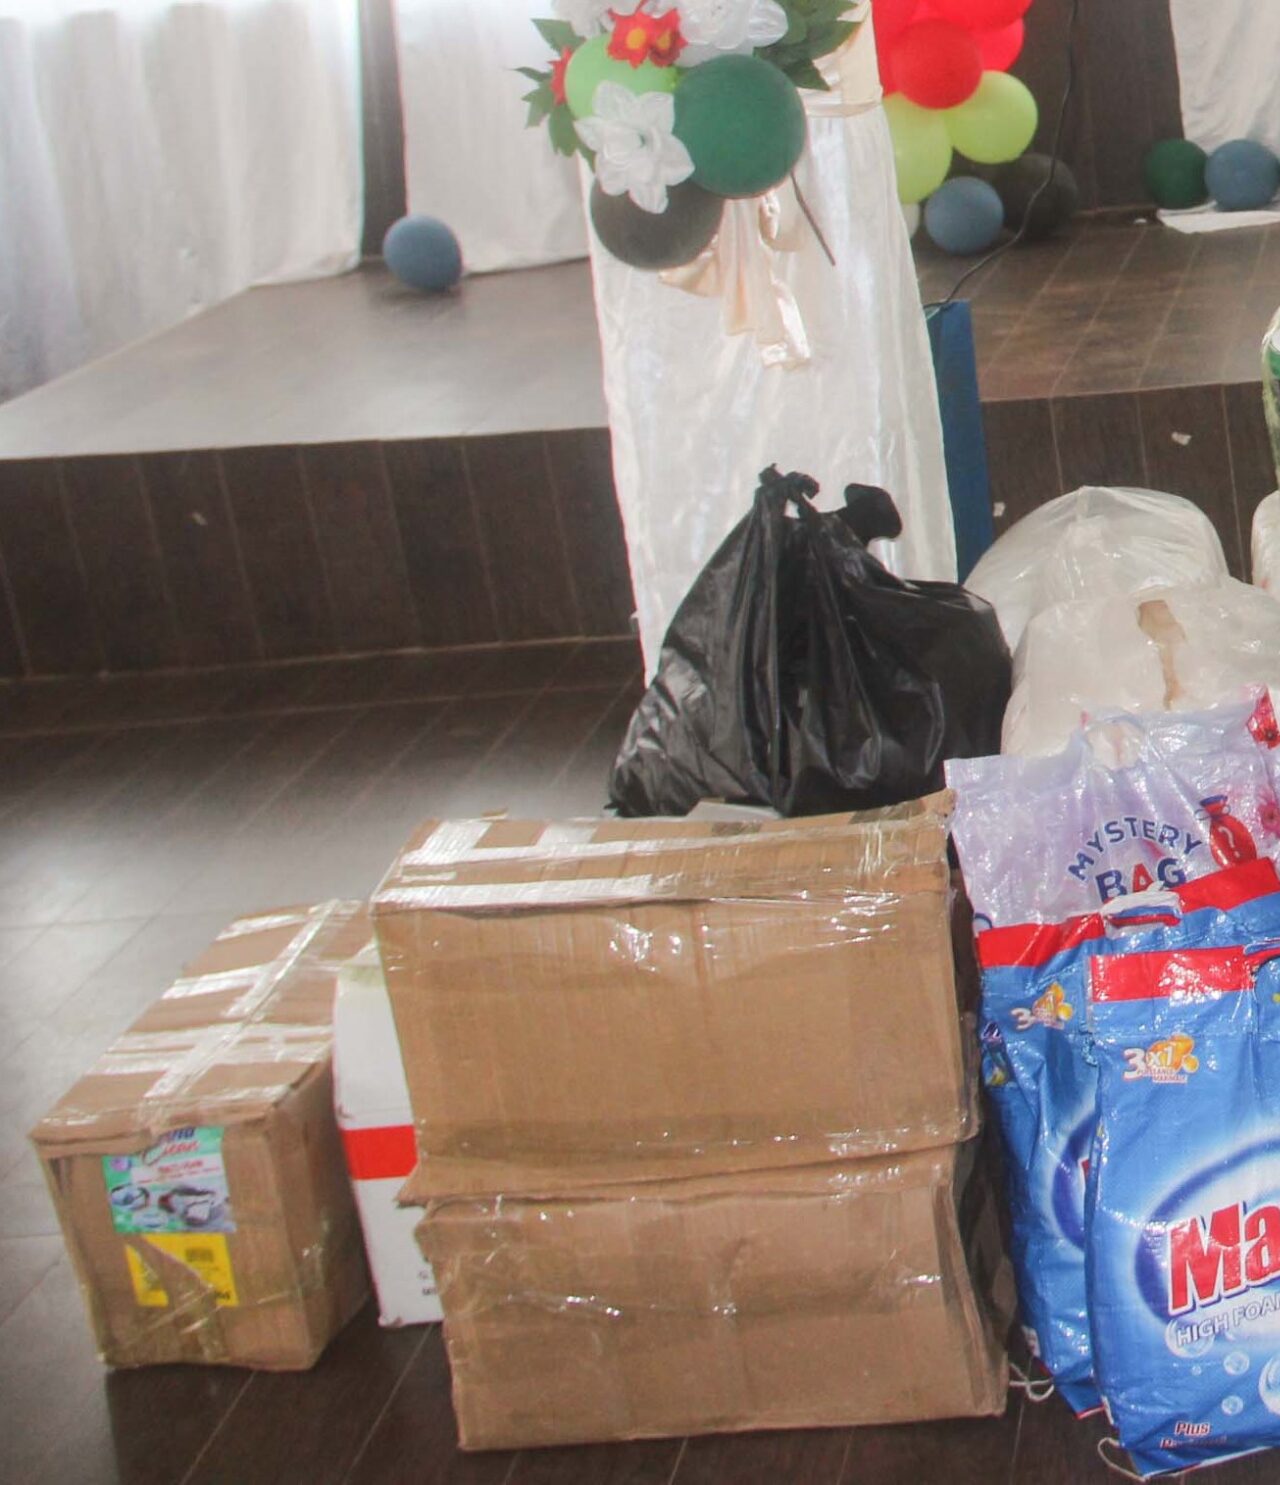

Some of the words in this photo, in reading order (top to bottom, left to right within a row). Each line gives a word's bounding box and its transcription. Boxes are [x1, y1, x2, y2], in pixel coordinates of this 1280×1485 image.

[1068, 817, 1202, 881] MYSTERY
[1096, 857, 1187, 903] BAG
[1177, 1311, 1230, 1347] HIGH
[1175, 1420, 1211, 1437] Plus
